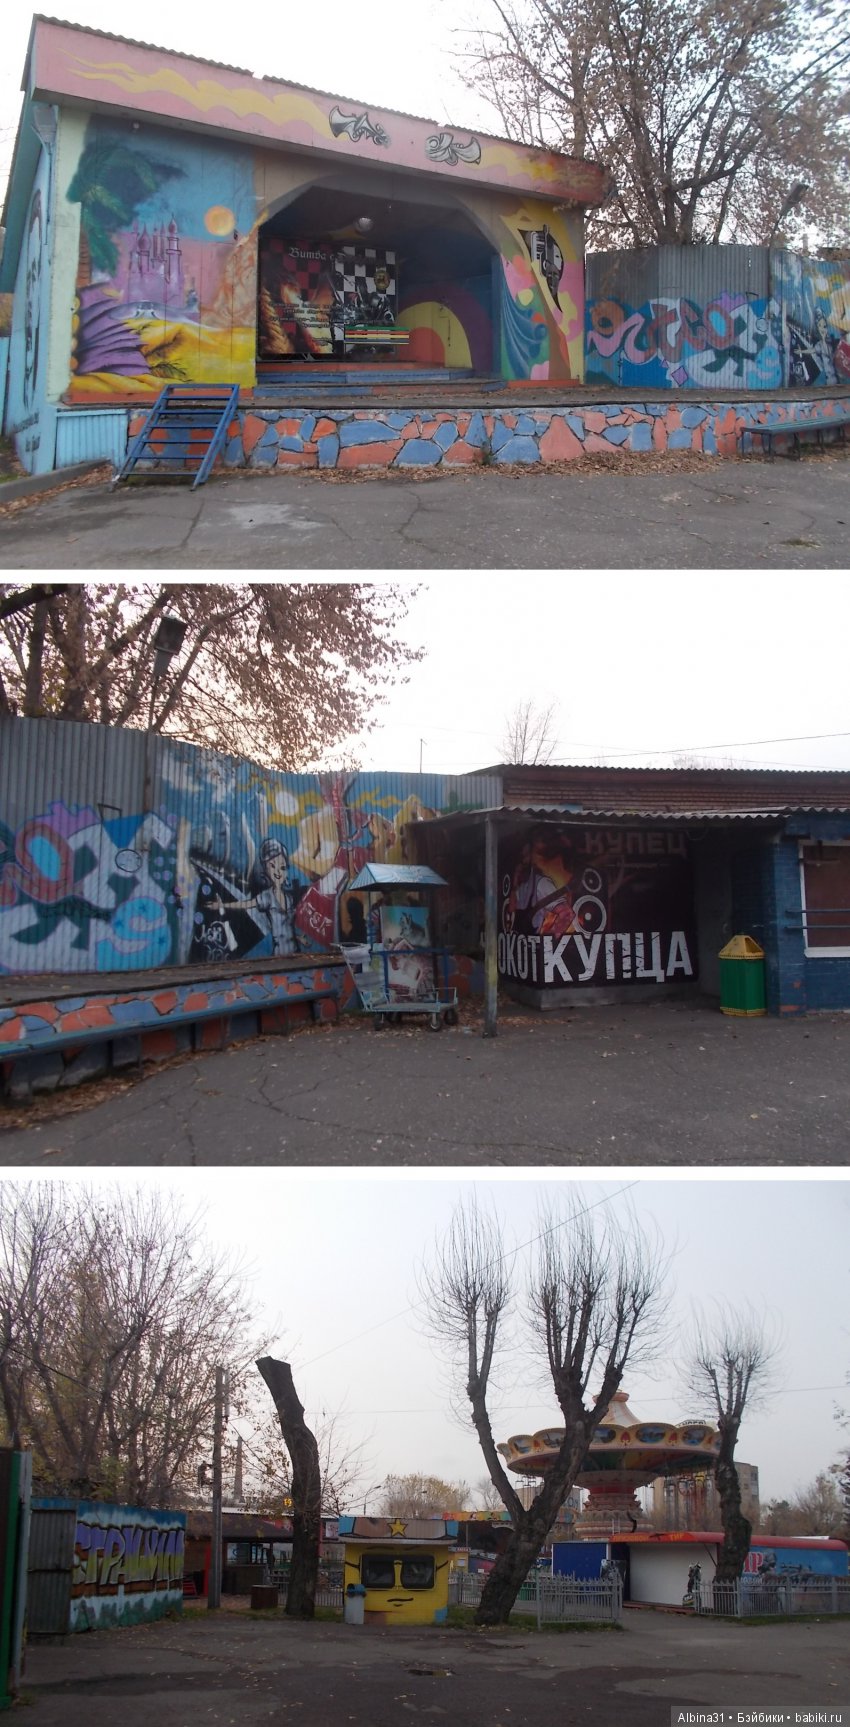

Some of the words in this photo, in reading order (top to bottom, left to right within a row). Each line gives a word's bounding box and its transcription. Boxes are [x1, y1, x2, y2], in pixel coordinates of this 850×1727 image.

[584, 831, 688, 857] КУПЕЦ
[480, 931, 542, 983] ОКОТ
[543, 930, 694, 983] КУПЦА
[742, 1551, 764, 1575] ИР
